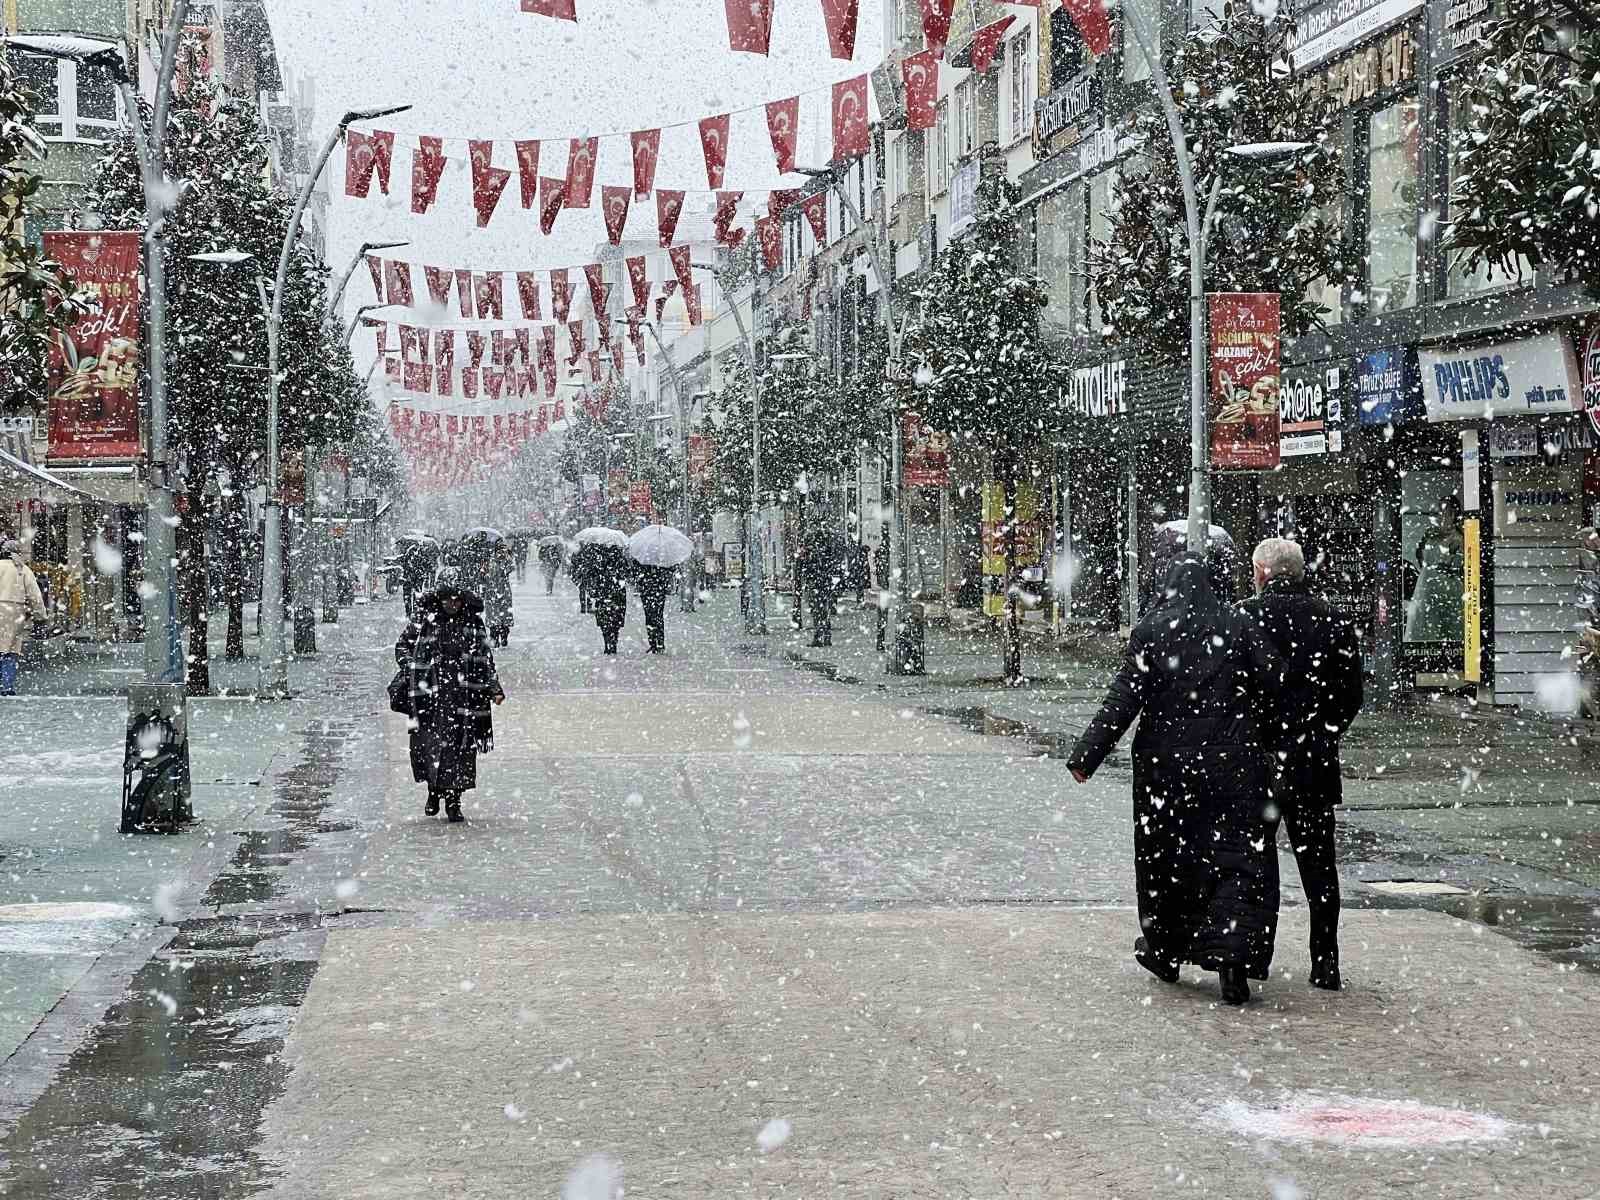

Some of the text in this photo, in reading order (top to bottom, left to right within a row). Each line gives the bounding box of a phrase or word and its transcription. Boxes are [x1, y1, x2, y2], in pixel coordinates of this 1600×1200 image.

[80, 301, 130, 342] çok!
[1236, 350, 1274, 379] çok!
[1433, 355, 1510, 404] PHILIPS
